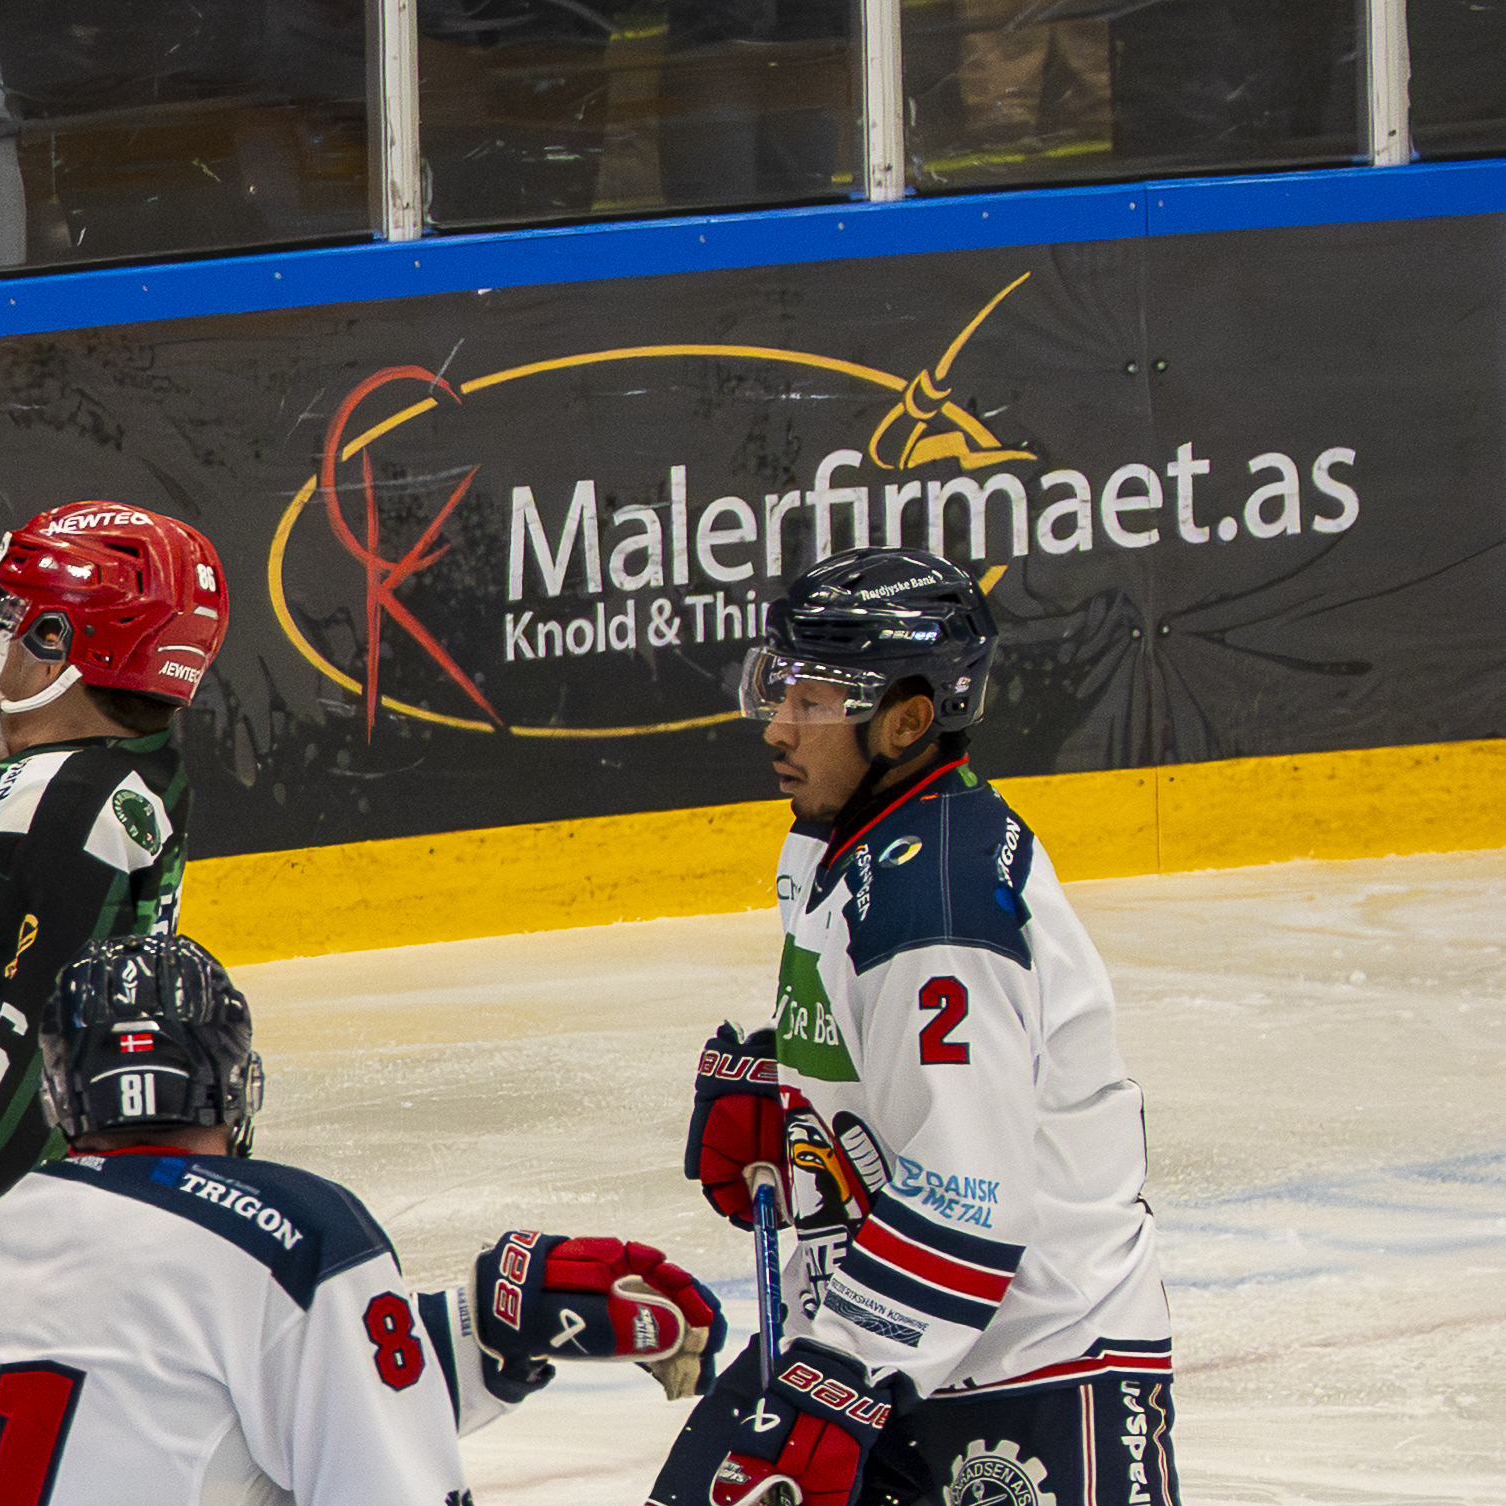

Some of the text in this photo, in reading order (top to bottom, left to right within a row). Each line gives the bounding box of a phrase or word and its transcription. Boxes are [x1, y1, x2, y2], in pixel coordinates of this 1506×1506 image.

[508, 441, 1360, 602] Malerfirmaet.as
[195, 562, 217, 592] 86
[910, 573, 938, 591] Bank
[504, 595, 636, 662] Knold
[649, 599, 682, 648] &
[918, 974, 971, 1066] 2
[119, 1072, 157, 1117] 81
[179, 1172, 304, 1251] TRIGON
[921, 1186, 993, 1230] METAL
[924, 1169, 1001, 1205] DANSK
[492, 1230, 542, 1332] BAU
[361, 1290, 427, 1392] 8
